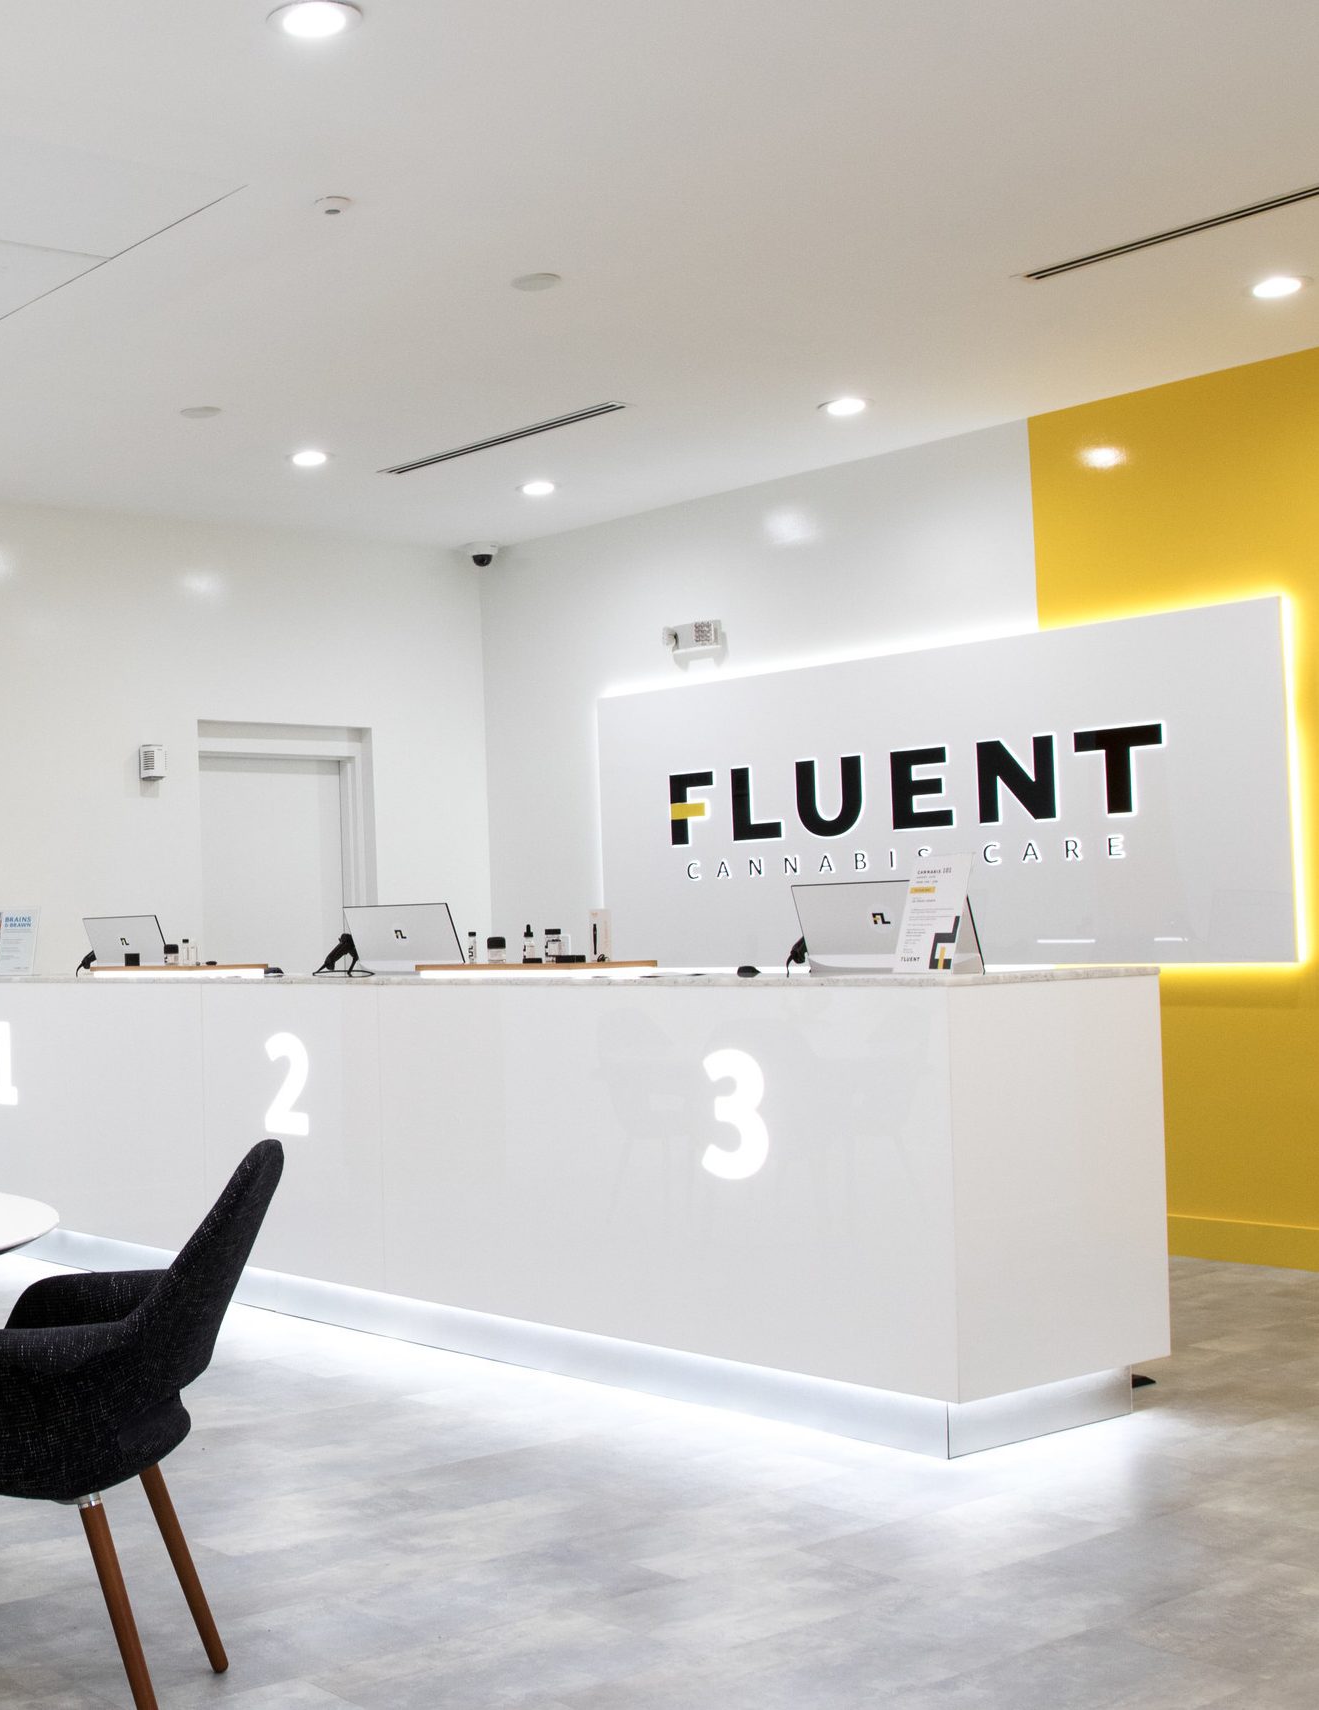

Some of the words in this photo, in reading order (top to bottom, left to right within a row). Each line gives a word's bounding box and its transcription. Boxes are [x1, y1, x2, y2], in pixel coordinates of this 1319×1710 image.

[668, 723, 1164, 846] FLUENT
[982, 837, 1123, 863] CARE
[264, 1031, 309, 1136] 2
[701, 1048, 769, 1180] 3
